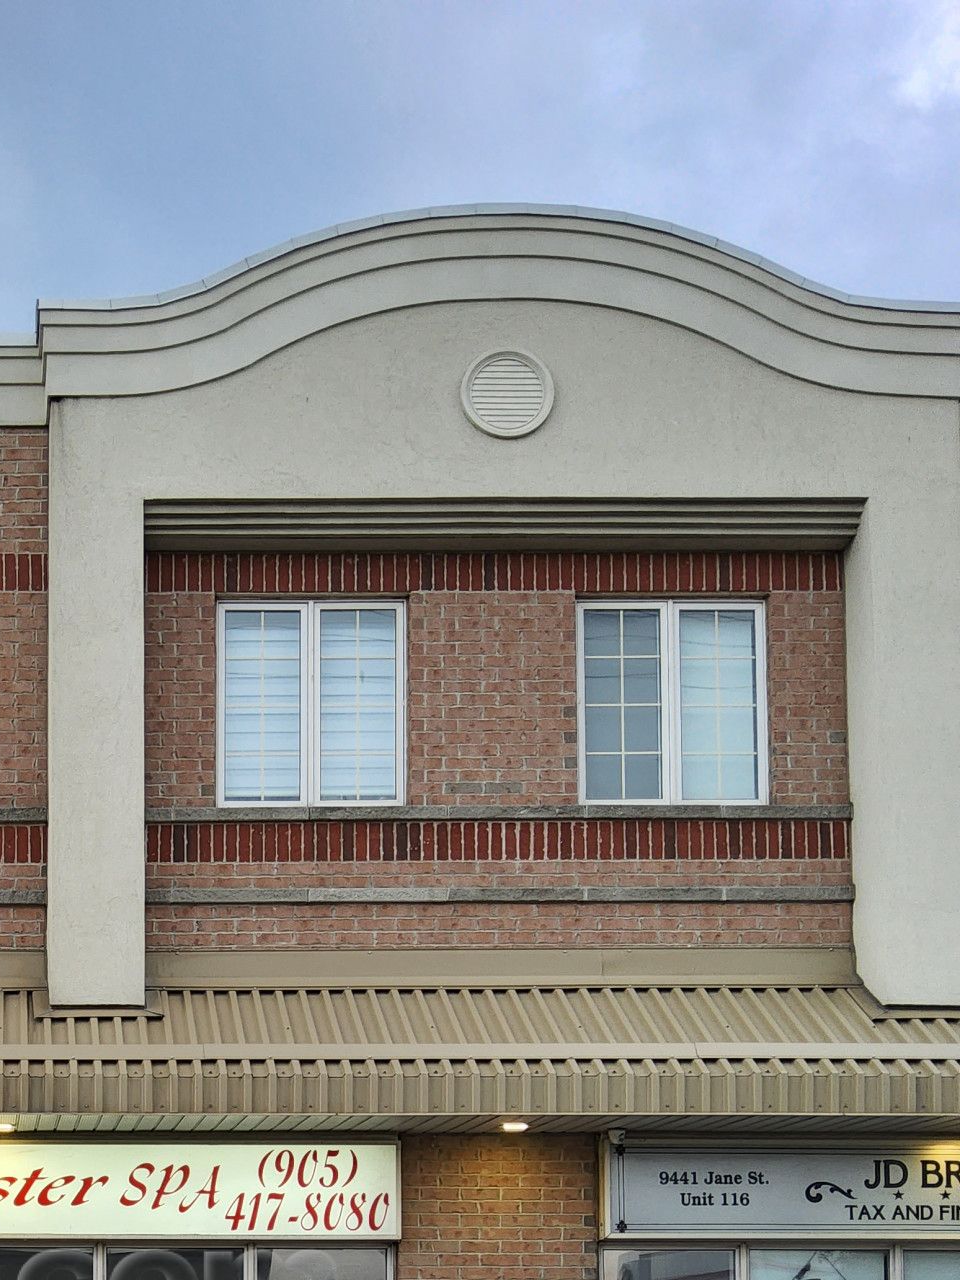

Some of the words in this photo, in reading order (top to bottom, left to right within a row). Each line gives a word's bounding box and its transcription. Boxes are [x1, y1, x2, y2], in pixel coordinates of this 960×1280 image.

[257, 1149, 358, 1188] (905)
[659, 1171, 699, 1185] 9441
[704, 1171, 743, 1185] Jane
[747, 1171, 770, 1185] St.
[864, 1159, 909, 1189] JD
[920, 1159, 960, 1188] BR
[119, 1162, 221, 1213] SPA
[680, 1192, 715, 1206] Unit
[721, 1192, 750, 1206] 116
[224, 1192, 390, 1231] 417-8080
[844, 1204, 886, 1220] TAX
[891, 1204, 934, 1220] AND
[939, 1204, 960, 1220] FI
